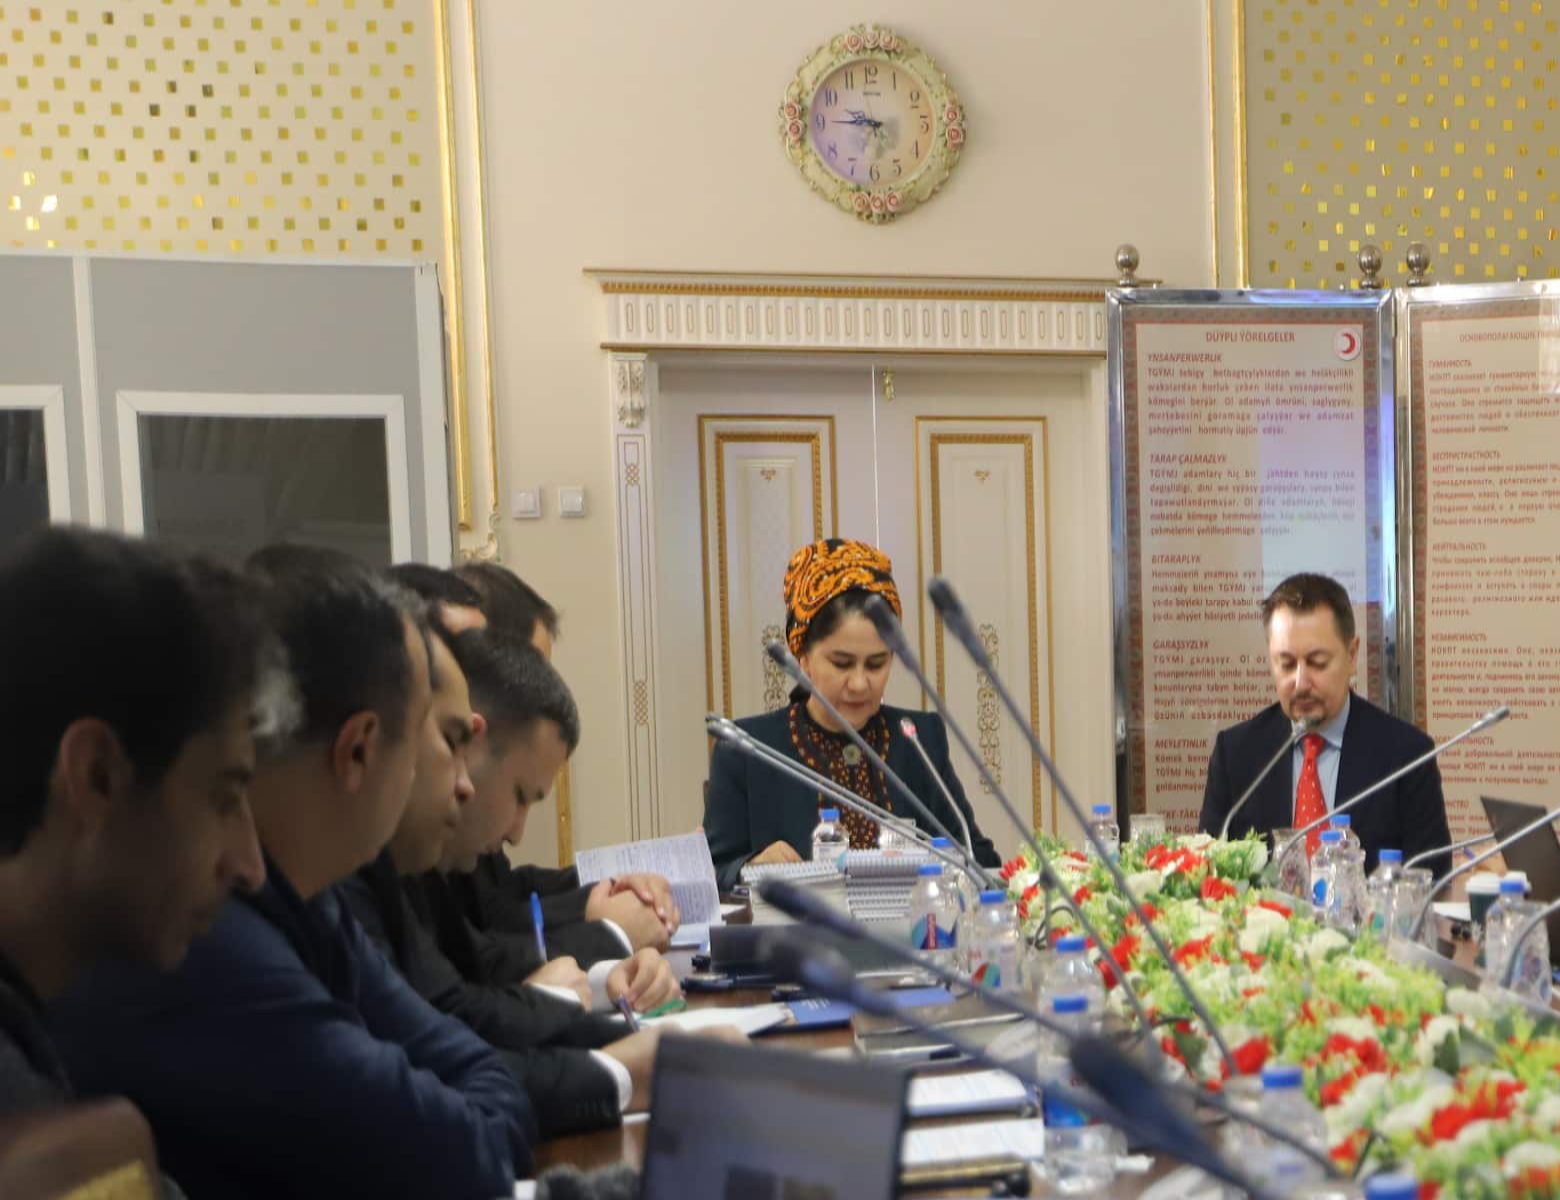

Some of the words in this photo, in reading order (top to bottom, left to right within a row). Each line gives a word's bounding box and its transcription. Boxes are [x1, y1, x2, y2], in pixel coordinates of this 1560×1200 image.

[845, 71, 854, 89] 11
[892, 71, 897, 89] 1
[825, 90, 837, 107] 10
[816, 114, 825, 130] 9
[828, 143, 838, 158] 8
[848, 157, 856, 176] 7
[869, 164, 880, 181] 6
